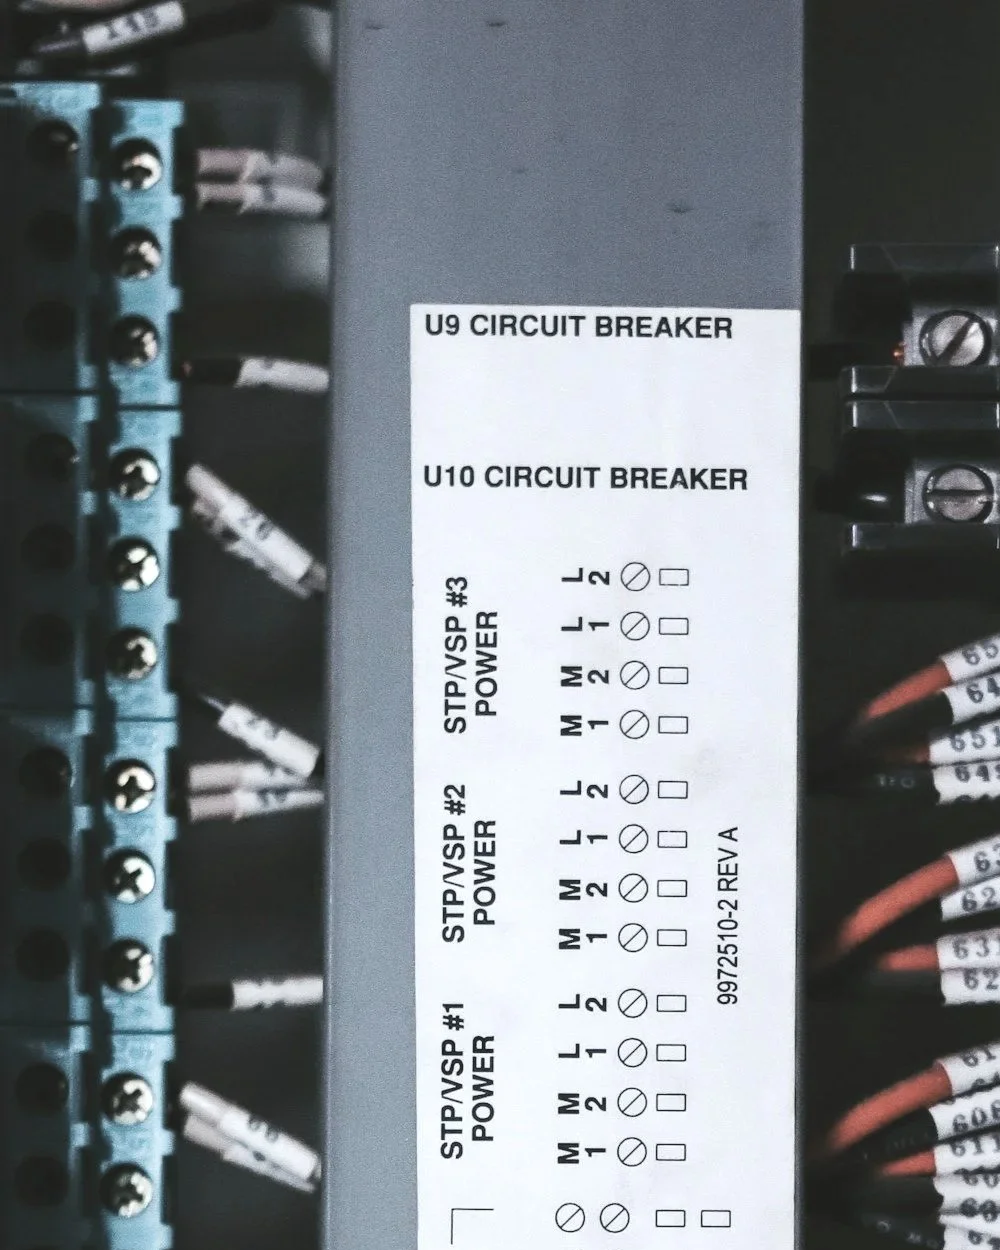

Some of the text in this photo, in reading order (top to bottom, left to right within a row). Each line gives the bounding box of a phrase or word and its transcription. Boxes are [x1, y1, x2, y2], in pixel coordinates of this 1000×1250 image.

[426, 314, 732, 338] U9 CIRCUIT BREAKER
[425, 466, 747, 490] U10 CIRCUIT BREAKER
[444, 577, 467, 733] STP/VSP #3
[475, 612, 497, 716] POWER
[442, 785, 465, 942] STP/VSP #2
[473, 821, 495, 925] POWER
[718, 840, 738, 891] REV
[717, 900, 738, 1004] 9972510-2
[441, 1004, 464, 1159] STP/VSP #1
[472, 1036, 494, 1141] POWER
